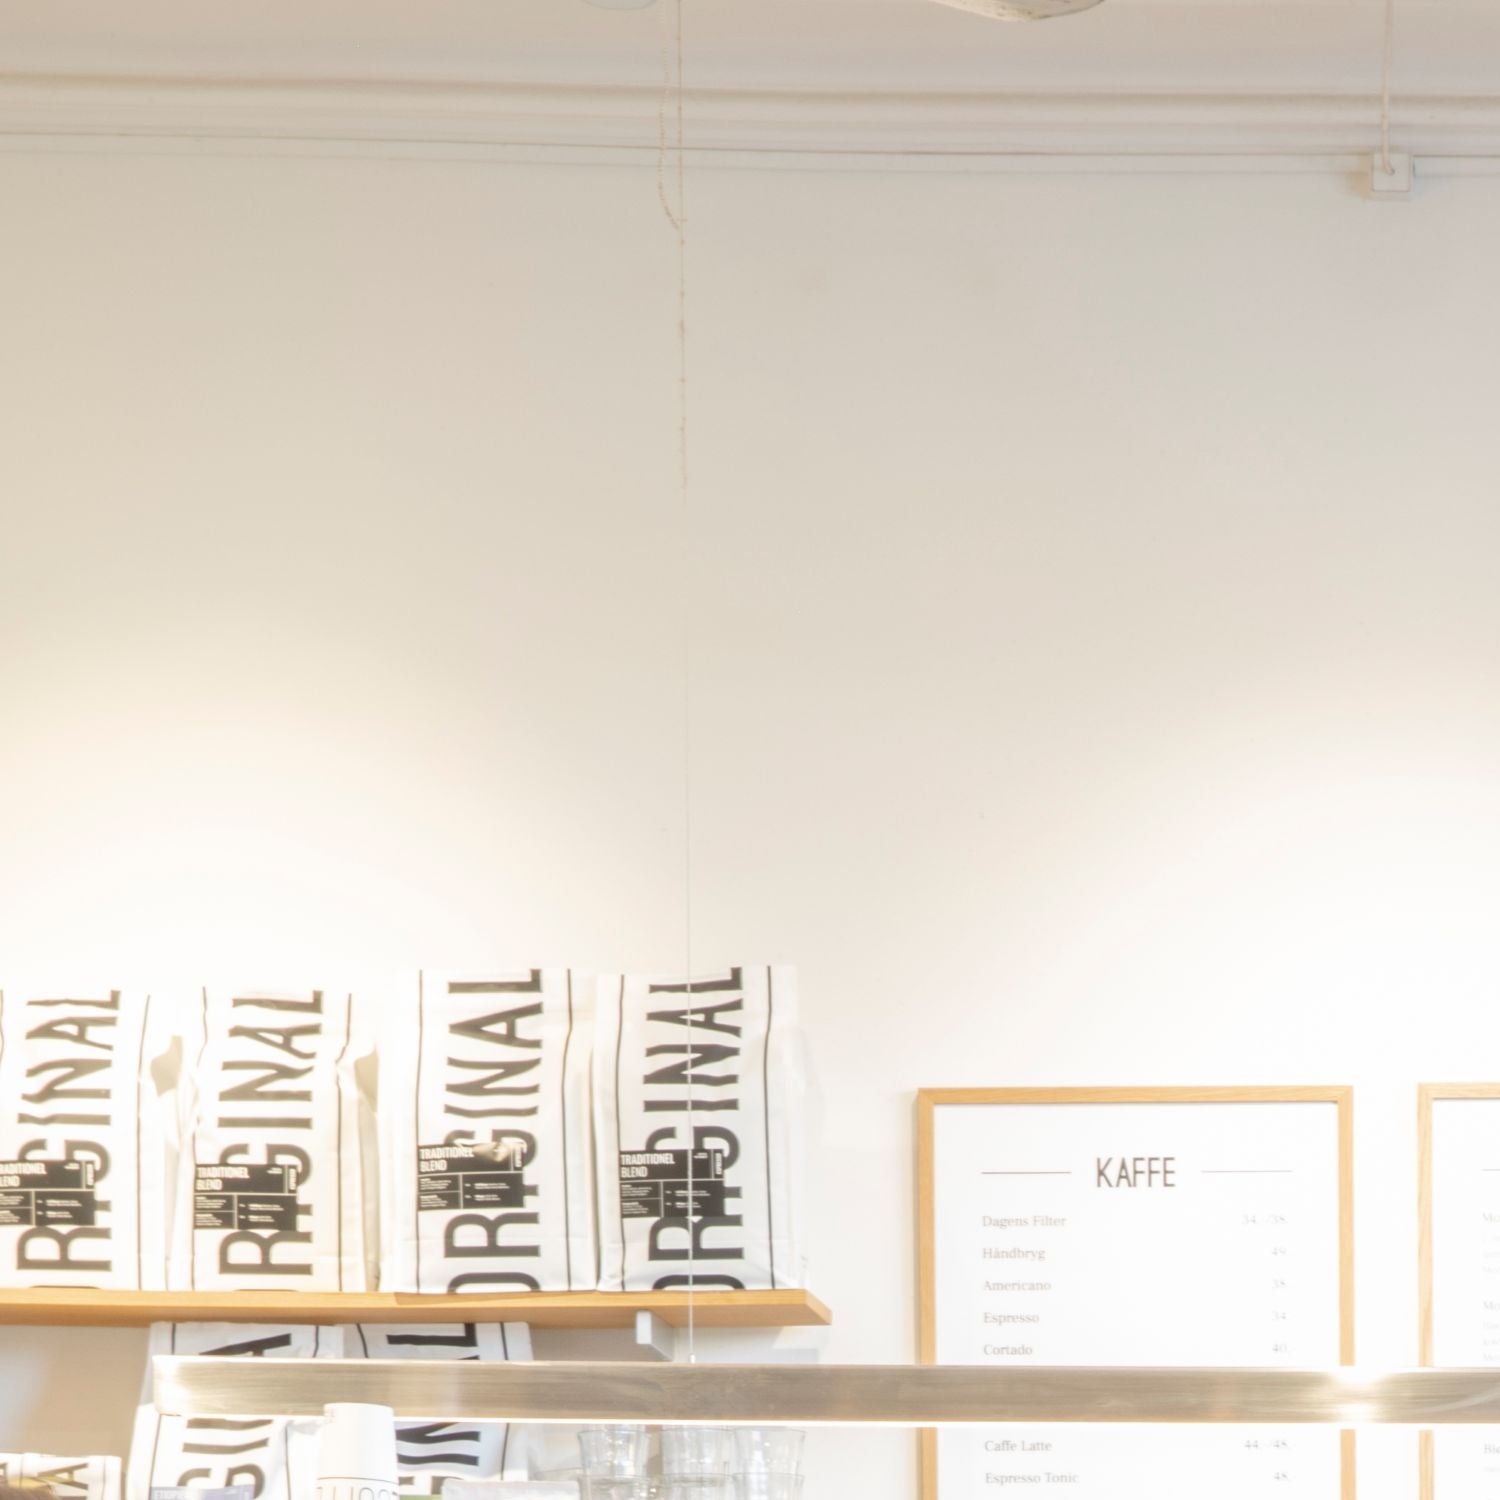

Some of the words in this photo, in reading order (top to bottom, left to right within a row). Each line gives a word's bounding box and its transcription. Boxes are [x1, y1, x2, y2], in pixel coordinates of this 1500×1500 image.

[620, 1153, 676, 1165] TRADITIONEL
[419, 1160, 448, 1172] BLEND
[620, 1166, 648, 1178] BLEND
[1095, 1156, 1177, 1188] KAFFE
[982, 1215, 1029, 1230] Dagens
[1033, 1215, 1067, 1226] Filter
[982, 1248, 1047, 1261] Håndbryg
[983, 1280, 1052, 1291] Americano
[983, 1312, 1040, 1326] Espresso
[983, 1344, 1033, 1355] Cortado
[1021, 1440, 1052, 1452] Latte
[985, 1473, 1041, 1486] Espresso
[1045, 1473, 1080, 1484] Tonic
